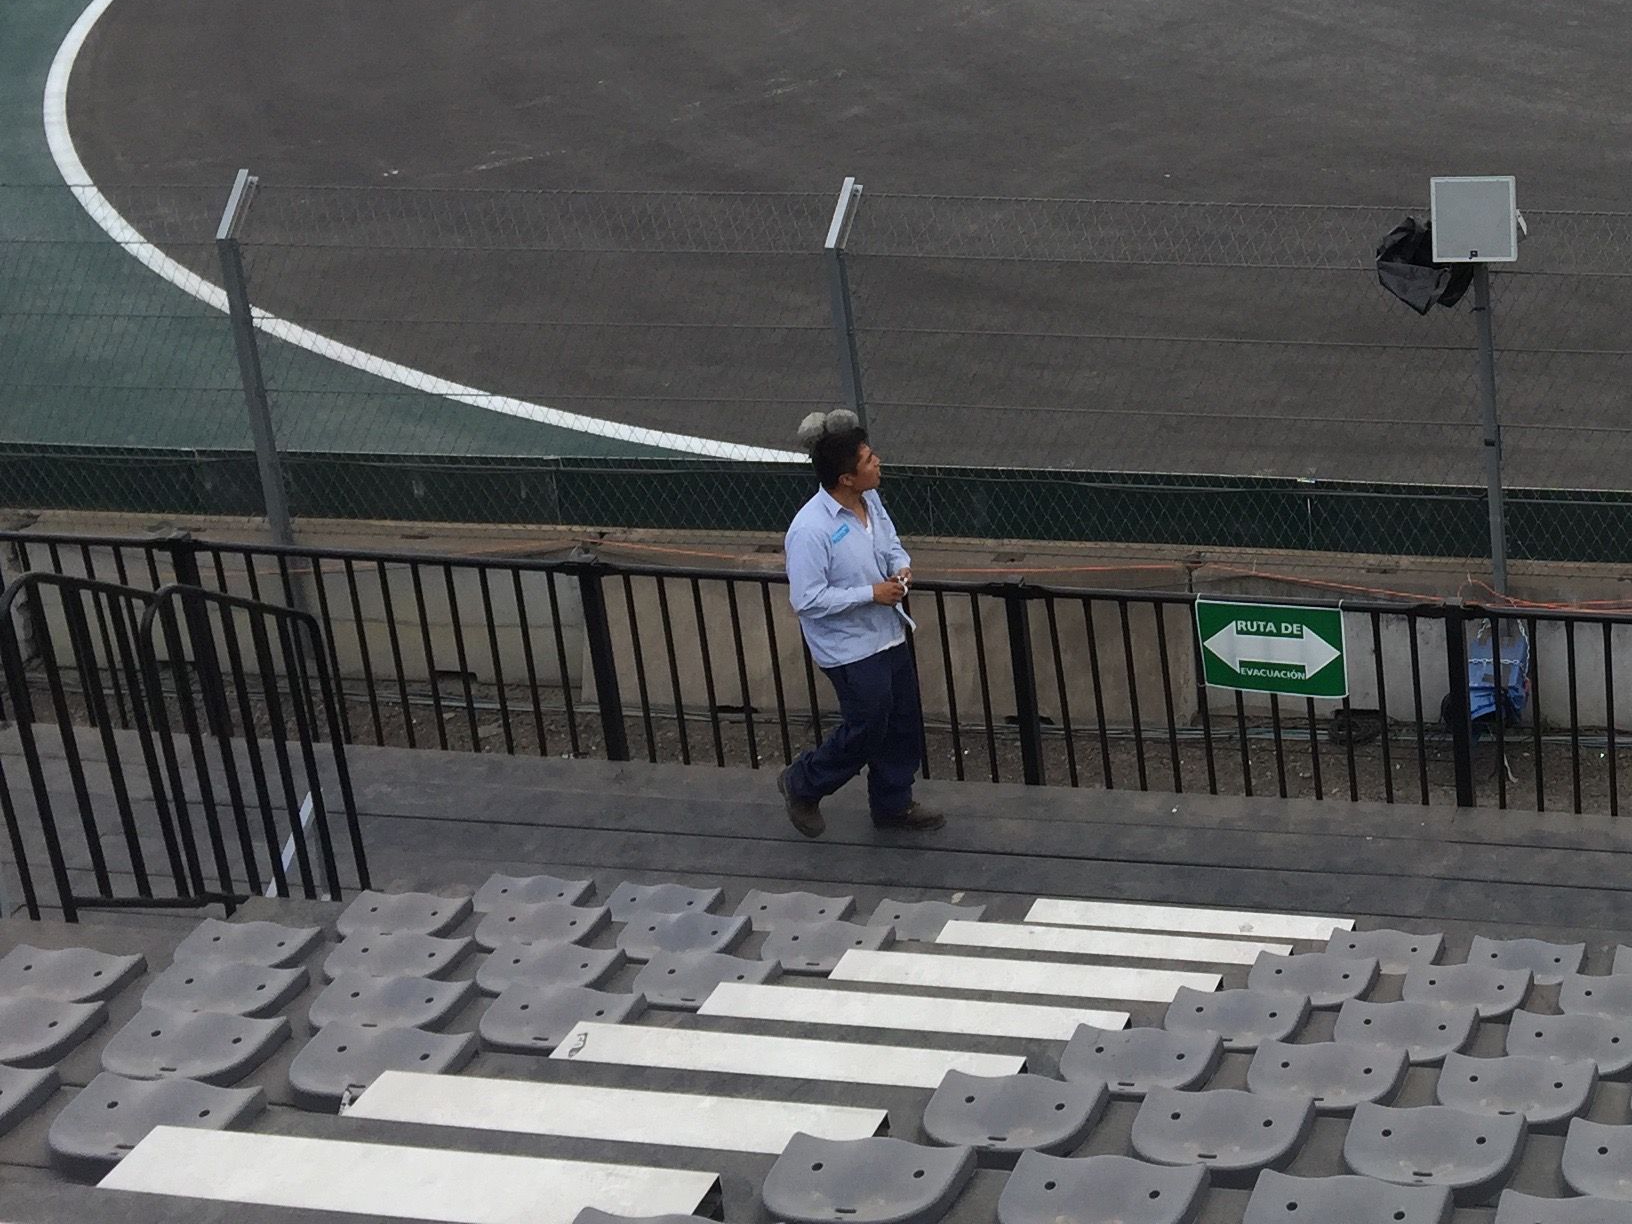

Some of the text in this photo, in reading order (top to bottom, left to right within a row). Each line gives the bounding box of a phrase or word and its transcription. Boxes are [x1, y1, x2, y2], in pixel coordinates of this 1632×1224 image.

[1237, 620, 1302, 635] RUTA DE
[1240, 667, 1306, 680] EVACUACIÓN
